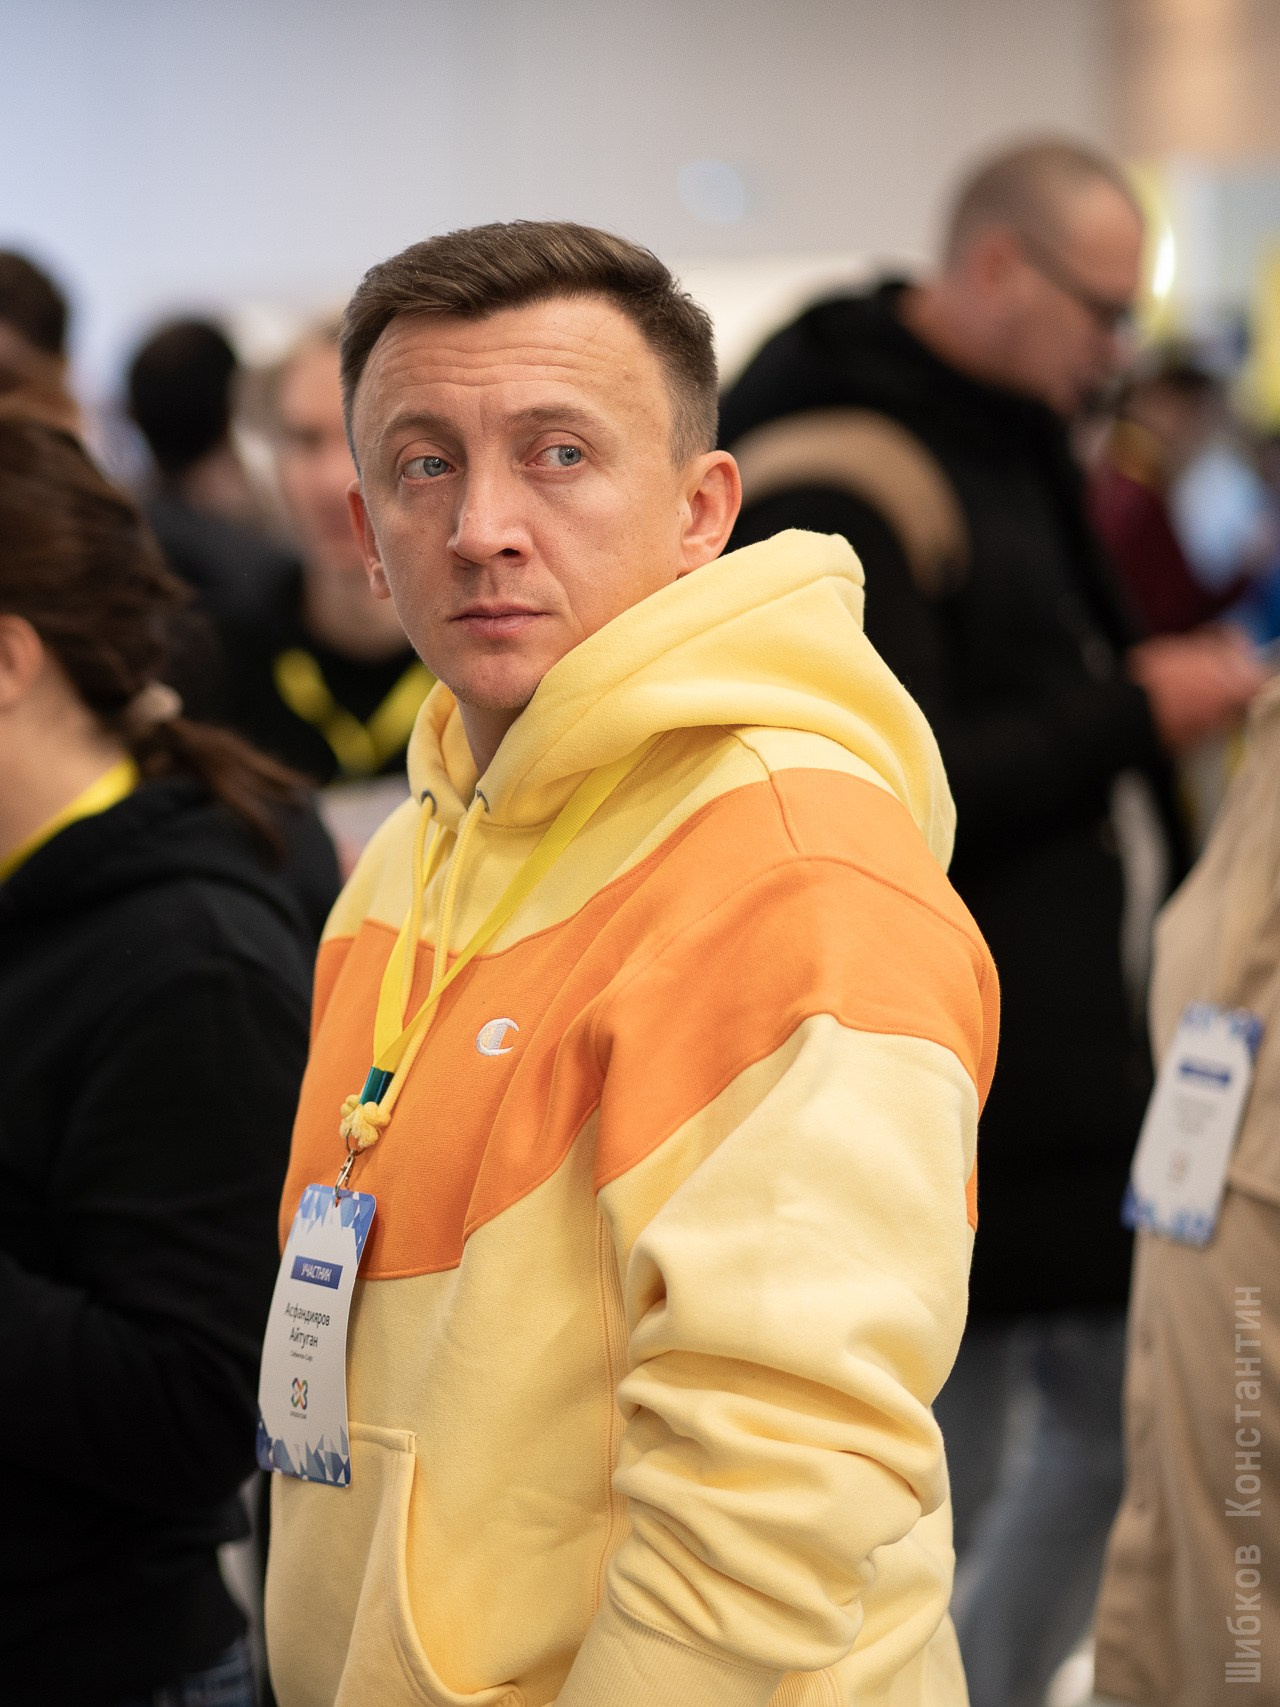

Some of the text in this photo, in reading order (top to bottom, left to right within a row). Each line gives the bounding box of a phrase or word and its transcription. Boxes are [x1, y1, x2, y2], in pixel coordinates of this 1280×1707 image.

[300, 1263, 333, 1282] УЧАСТНИК
[284, 1302, 331, 1329] Асфандияров
[288, 1327, 320, 1349] Айтуган
